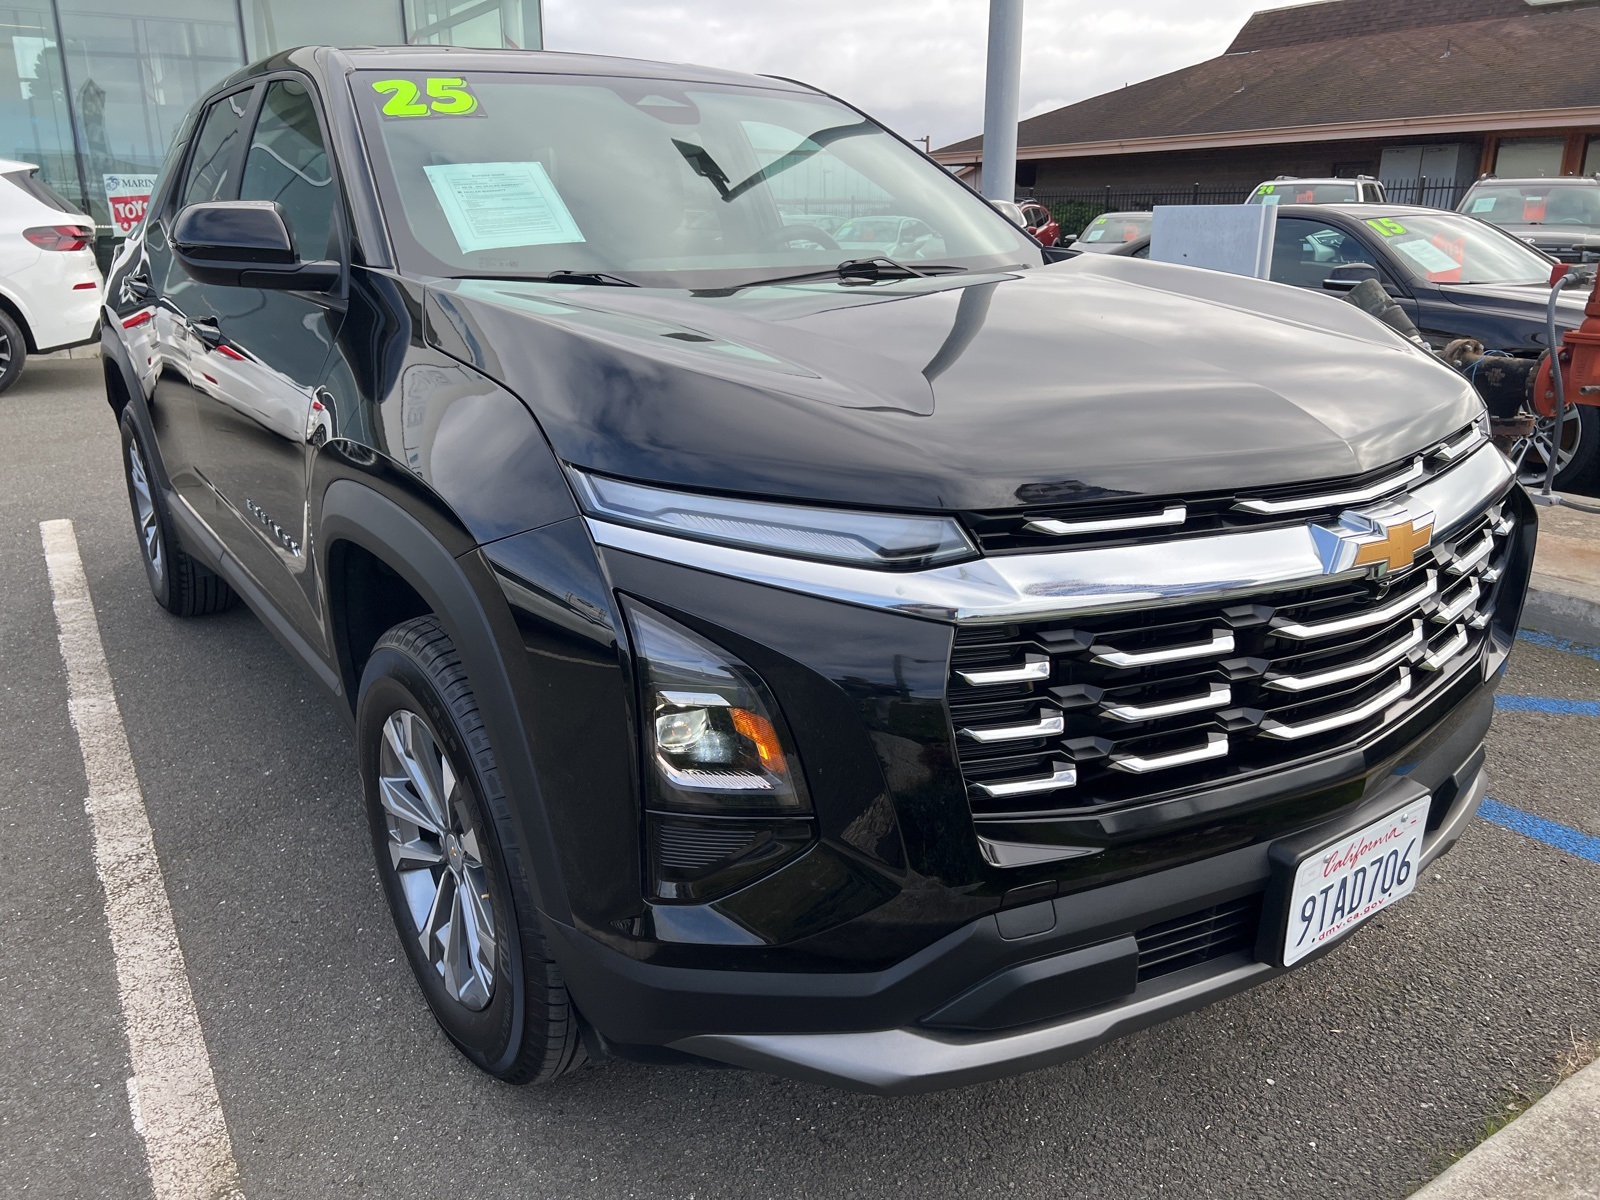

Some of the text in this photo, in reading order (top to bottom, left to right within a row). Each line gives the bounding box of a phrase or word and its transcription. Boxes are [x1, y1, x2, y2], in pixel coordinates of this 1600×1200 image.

[371, 77, 478, 118] 25
[1366, 217, 1407, 238] 15
[1323, 826, 1404, 878] California
[1296, 838, 1416, 947] 9TAD706
[1318, 898, 1385, 941] dmv.ca.gov
